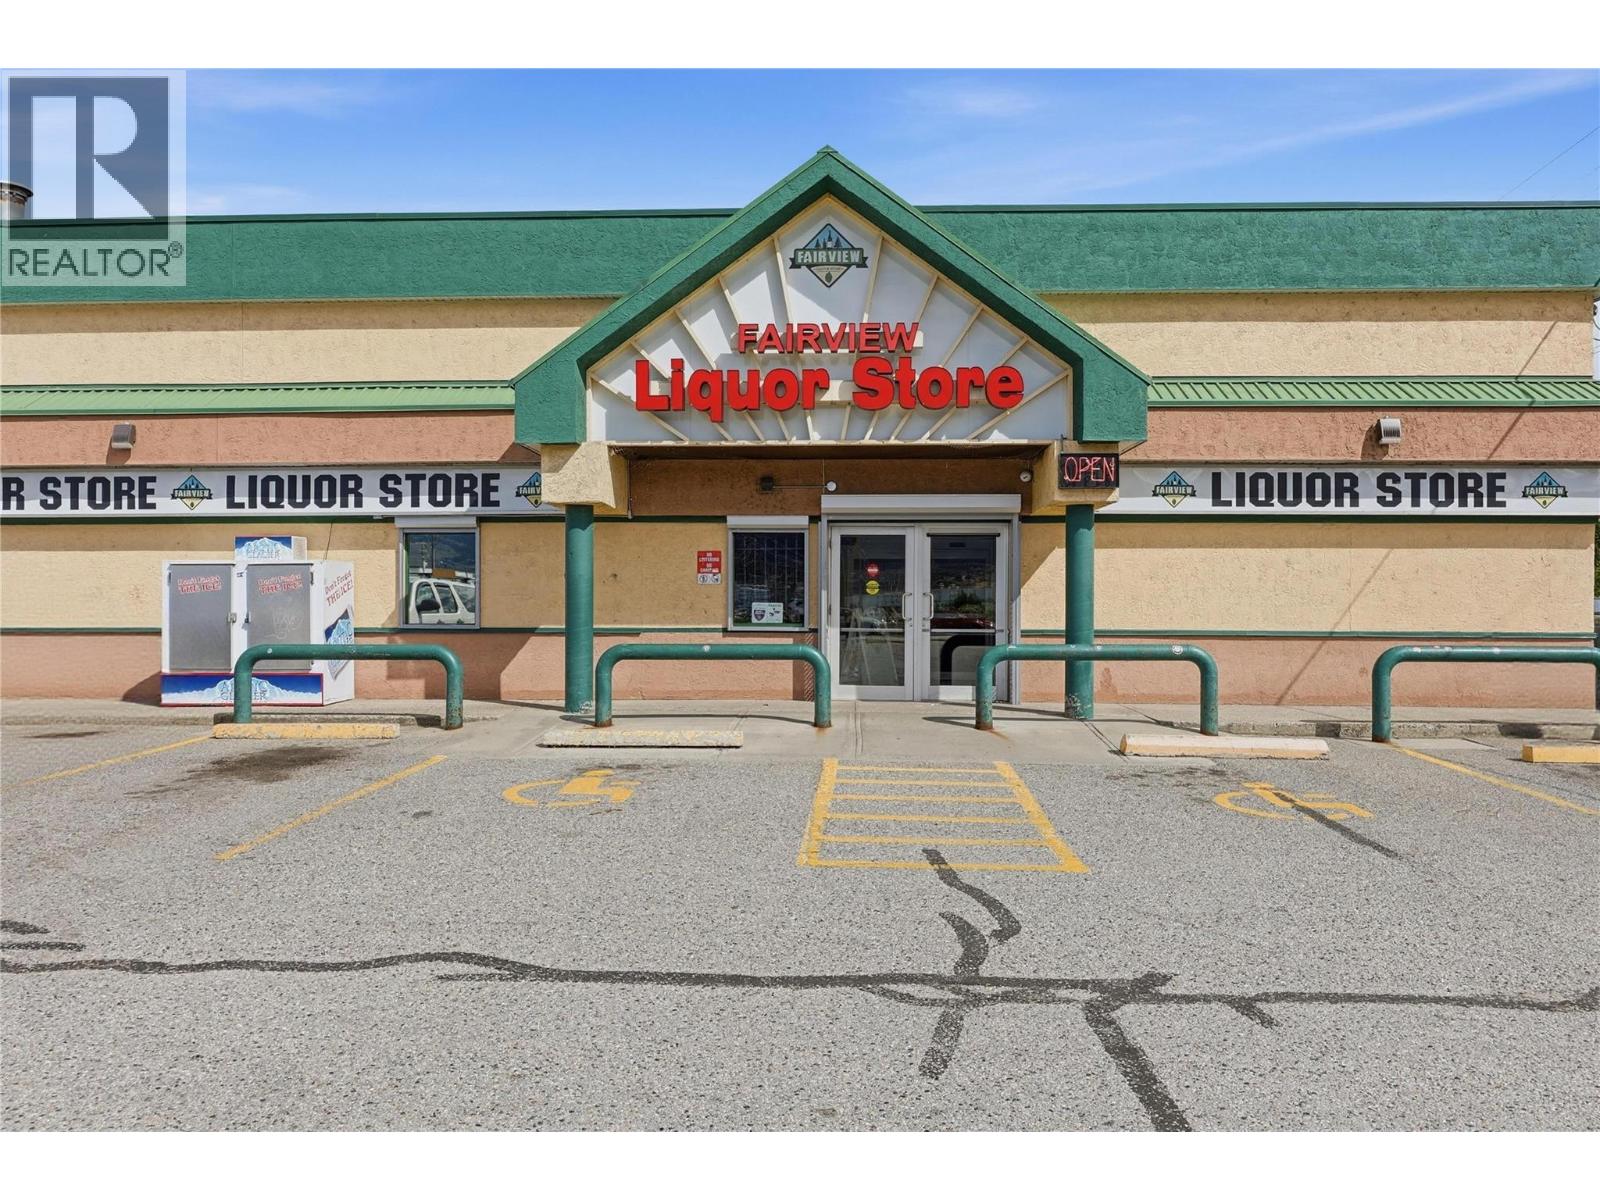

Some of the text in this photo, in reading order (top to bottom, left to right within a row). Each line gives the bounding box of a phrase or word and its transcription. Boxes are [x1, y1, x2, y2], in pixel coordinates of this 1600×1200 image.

[797, 249, 861, 263] FAIRVIEW
[737, 322, 920, 354] FAIRVIEW
[635, 355, 1025, 423] Liquor Store
[1063, 456, 1115, 482] OPEN
[39, 476, 157, 511] STORE
[175, 489, 209, 498] FAIRVIEW
[226, 473, 501, 509] LIQUOR STORE
[519, 486, 541, 495] FAIRV
[1156, 486, 1193, 495] FAIRVIEW
[1211, 471, 1507, 508] LIQUOR STORE
[1525, 487, 1564, 495] FAIRVIEW
